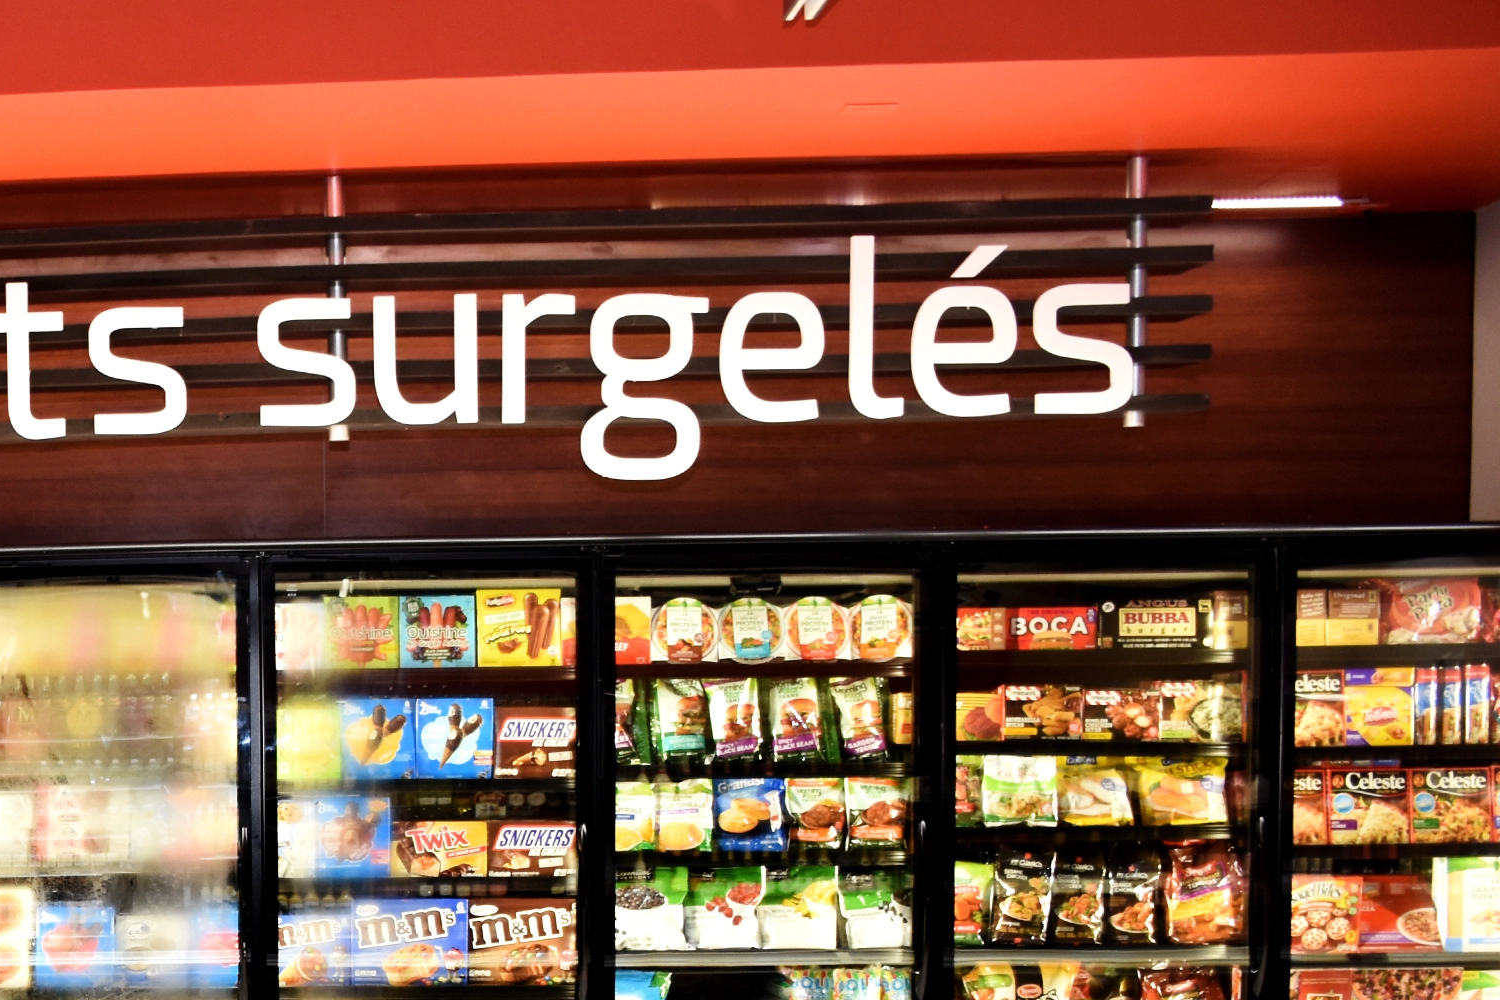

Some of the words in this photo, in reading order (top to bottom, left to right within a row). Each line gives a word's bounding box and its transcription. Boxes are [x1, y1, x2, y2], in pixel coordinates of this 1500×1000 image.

[256, 234, 1135, 481] surgelés
[1126, 599, 1188, 607] ANGUS
[1404, 585, 1450, 607] Party
[1010, 616, 1089, 636] BOCA
[1123, 612, 1190, 625] BUBBA
[406, 625, 467, 640] Outshine
[483, 630, 509, 644] FUDGE
[508, 625, 532, 637] POPS
[1126, 626, 1190, 634] burger
[421, 640, 441, 648] Sugar
[443, 639, 468, 647] Added
[503, 721, 574, 738] SNICKERS
[532, 739, 544, 747] ICE
[545, 739, 569, 747] CREAM
[796, 739, 814, 747] BEAN
[1345, 772, 1406, 790] Celeste
[1426, 771, 1486, 789] Celeste
[406, 825, 470, 852] Twix
[498, 828, 574, 846] SNICKERS
[528, 848, 542, 857] ICE
[543, 848, 568, 857] CREAM
[358, 908, 455, 948] m&m's
[472, 908, 570, 948] m&m's
